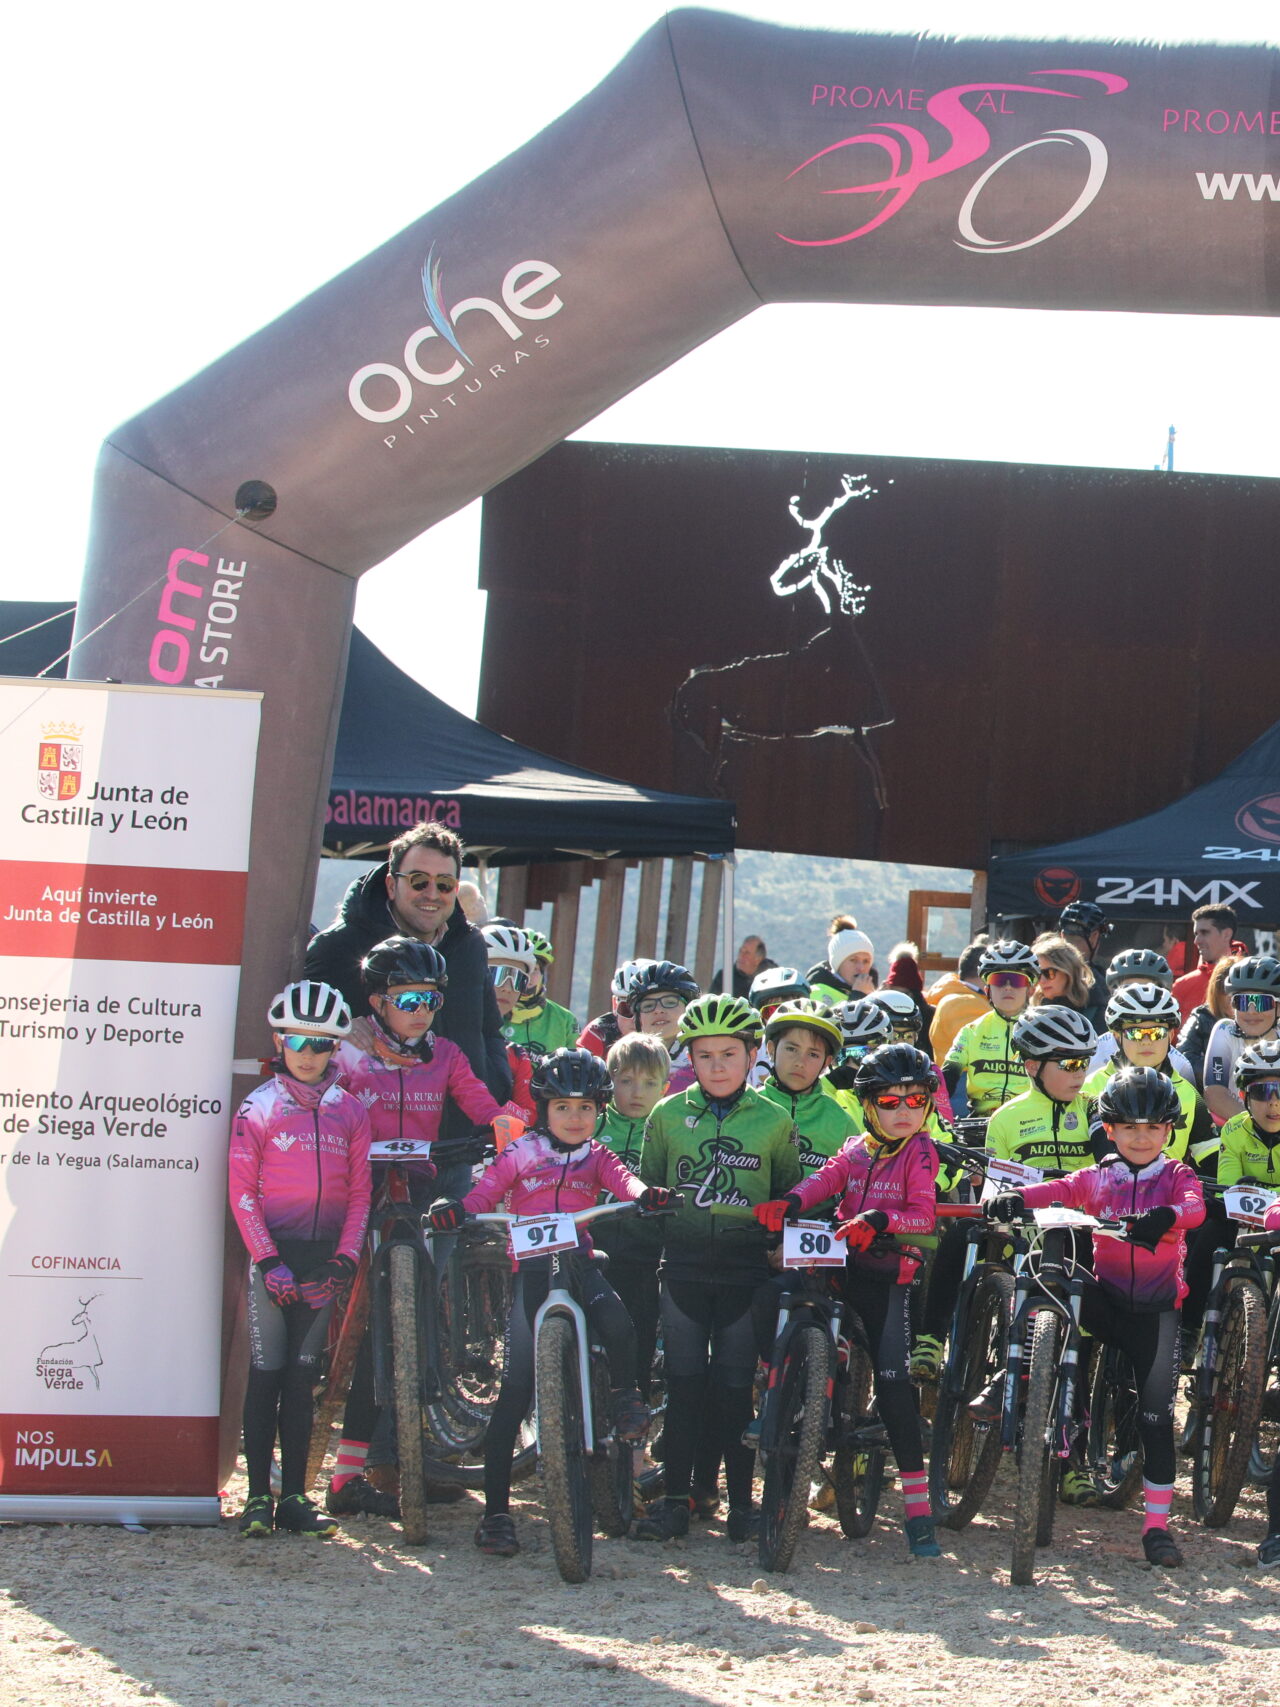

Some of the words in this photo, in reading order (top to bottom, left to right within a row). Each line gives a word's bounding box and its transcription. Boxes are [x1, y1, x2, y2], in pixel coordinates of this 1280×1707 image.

[383, 333, 551, 449] PINTURAS
[200, 557, 247, 666] STORE
[87, 782, 154, 804] Junta
[160, 786, 190, 805] de
[21, 804, 104, 827] Castilla
[110, 812, 124, 834] y
[131, 810, 188, 831] León
[41, 885, 83, 906] Aquí
[88, 888, 158, 907] invierte
[1095, 877, 1264, 909] 24MX
[4, 905, 53, 922] Junta
[59, 907, 81, 923] de
[87, 909, 150, 927] Castilla
[156, 914, 166, 931] y
[172, 911, 214, 929] León
[97, 996, 121, 1014] de
[128, 997, 202, 1017] Cultura
[0, 1020, 79, 1040] Turismo
[86, 1026, 97, 1045] y
[103, 1024, 185, 1046] Deporte
[983, 1062, 1025, 1074] ALJOMA
[79, 1091, 222, 1118] Arqueológico
[3, 1114, 30, 1134] de
[38, 1115, 95, 1140] Siega
[103, 1117, 168, 1138] Verde
[1030, 1144, 1086, 1155] ALJOMAR
[12, 1151, 31, 1165] de
[37, 1152, 50, 1166] la
[56, 1153, 101, 1170] Yegua
[107, 1154, 200, 1173] (Salamanca)
[1239, 1195, 1267, 1214] 62
[528, 1223, 559, 1247] 97
[799, 1232, 832, 1255] 80
[31, 1256, 122, 1271] COFINANCIA
[36, 1366, 73, 1380] Siega
[44, 1377, 84, 1391] Verde
[17, 1431, 55, 1445] NOS
[15, 1448, 113, 1471] IMPULSA
